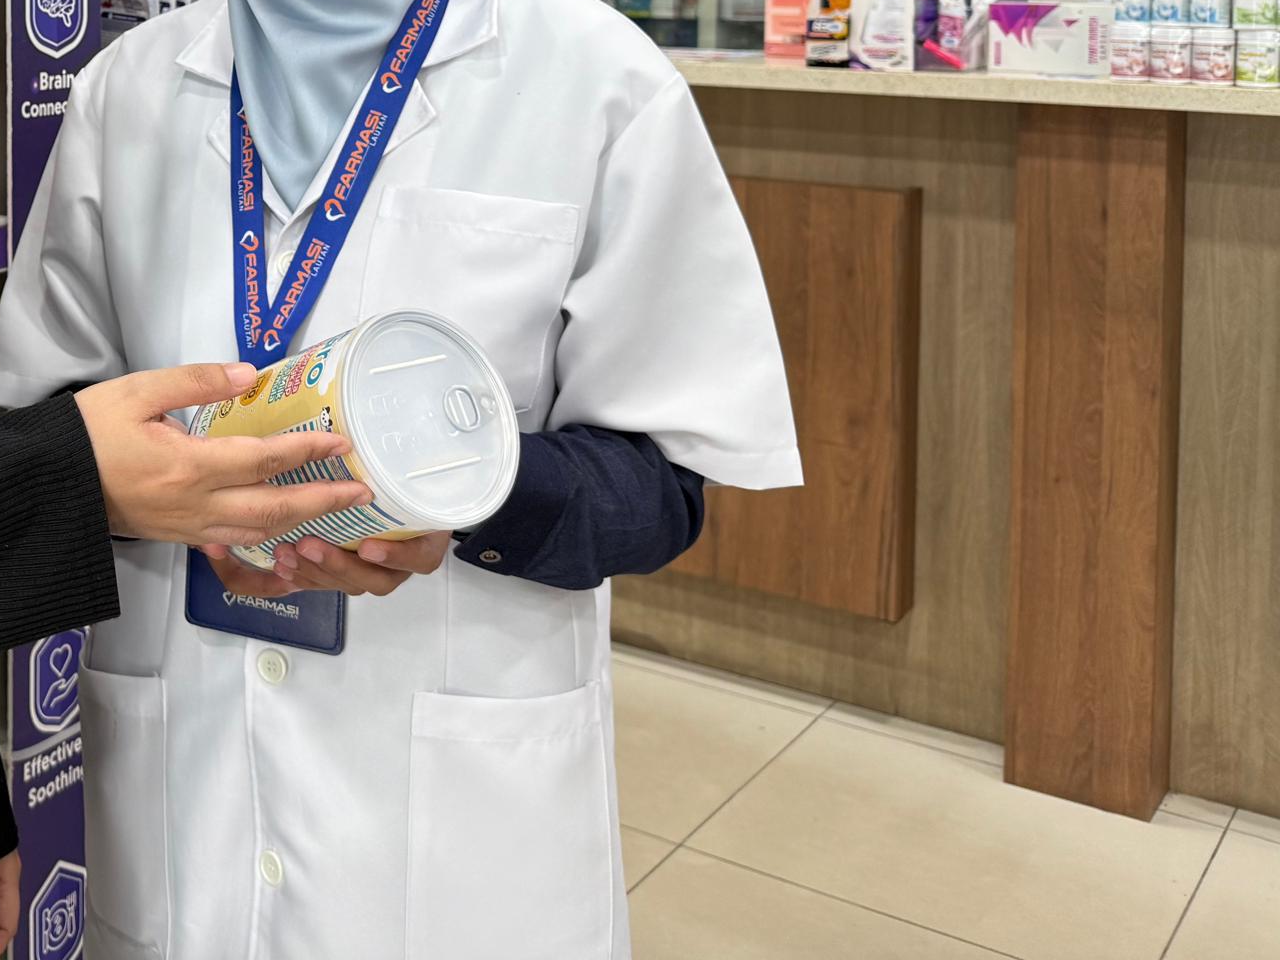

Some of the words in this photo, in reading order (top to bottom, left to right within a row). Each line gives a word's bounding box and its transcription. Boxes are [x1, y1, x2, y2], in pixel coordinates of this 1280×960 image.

[39, 71, 75, 91] Brain
[370, 114, 387, 147] LAUTAN
[336, 110, 383, 200] FARMASI
[311, 244, 330, 278] LAUTAN
[273, 238, 325, 330] FARMASI
[243, 313, 253, 349] LAUTAN
[237, 593, 299, 615] FARMASI
[24, 736, 82, 781] Effective
